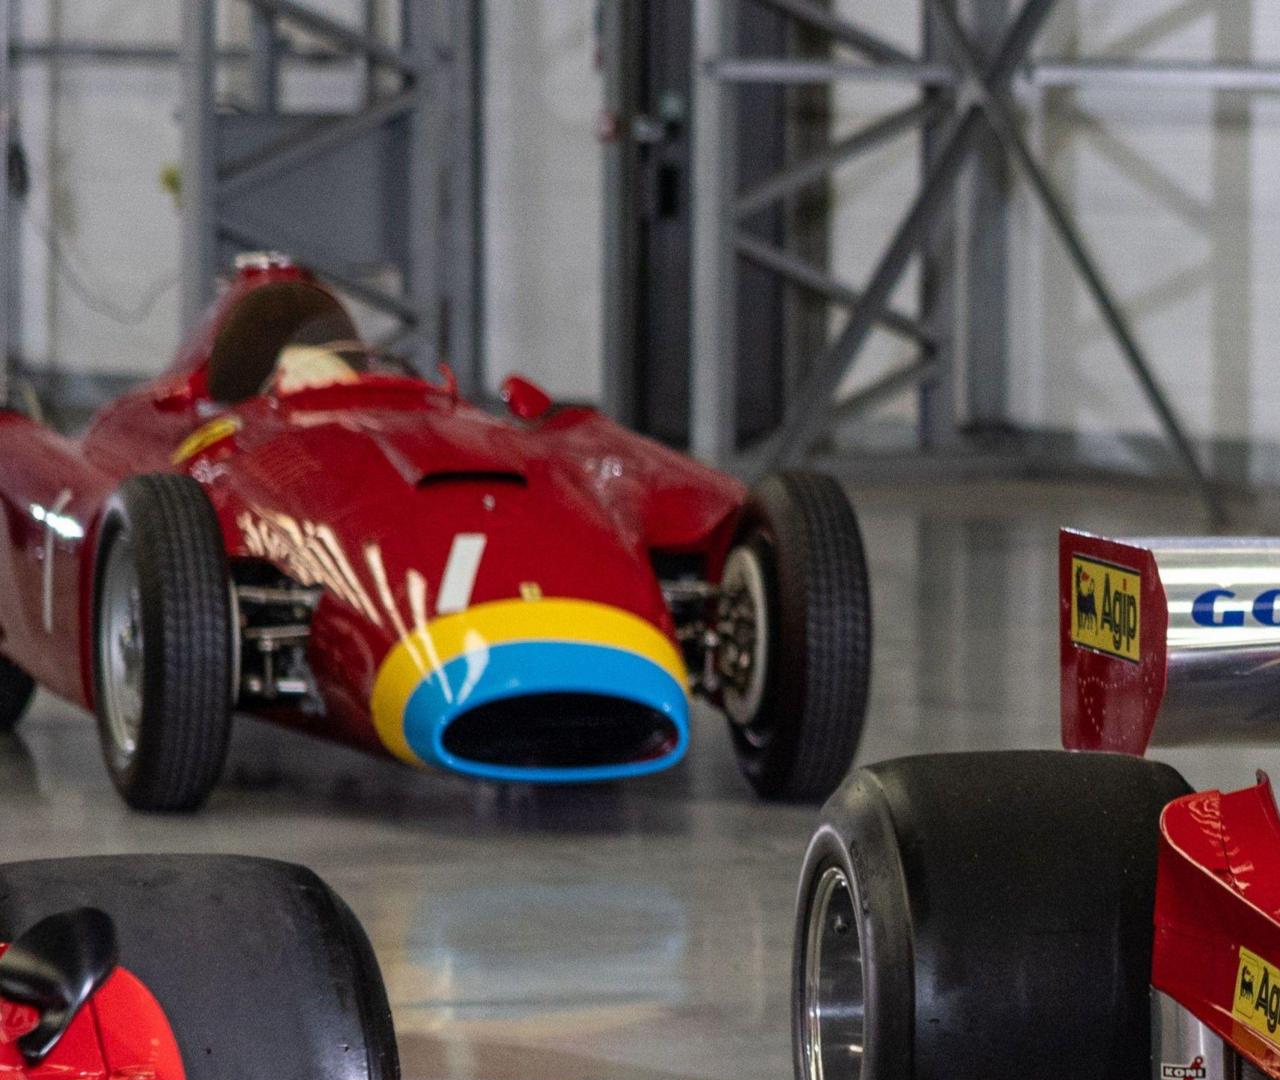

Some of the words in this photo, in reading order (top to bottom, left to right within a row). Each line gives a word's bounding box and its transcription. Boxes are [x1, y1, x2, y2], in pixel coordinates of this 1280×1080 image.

[436, 532, 487, 615] 1
[1101, 574, 1137, 650] Agip
[1164, 1066, 1204, 1079] KONI
